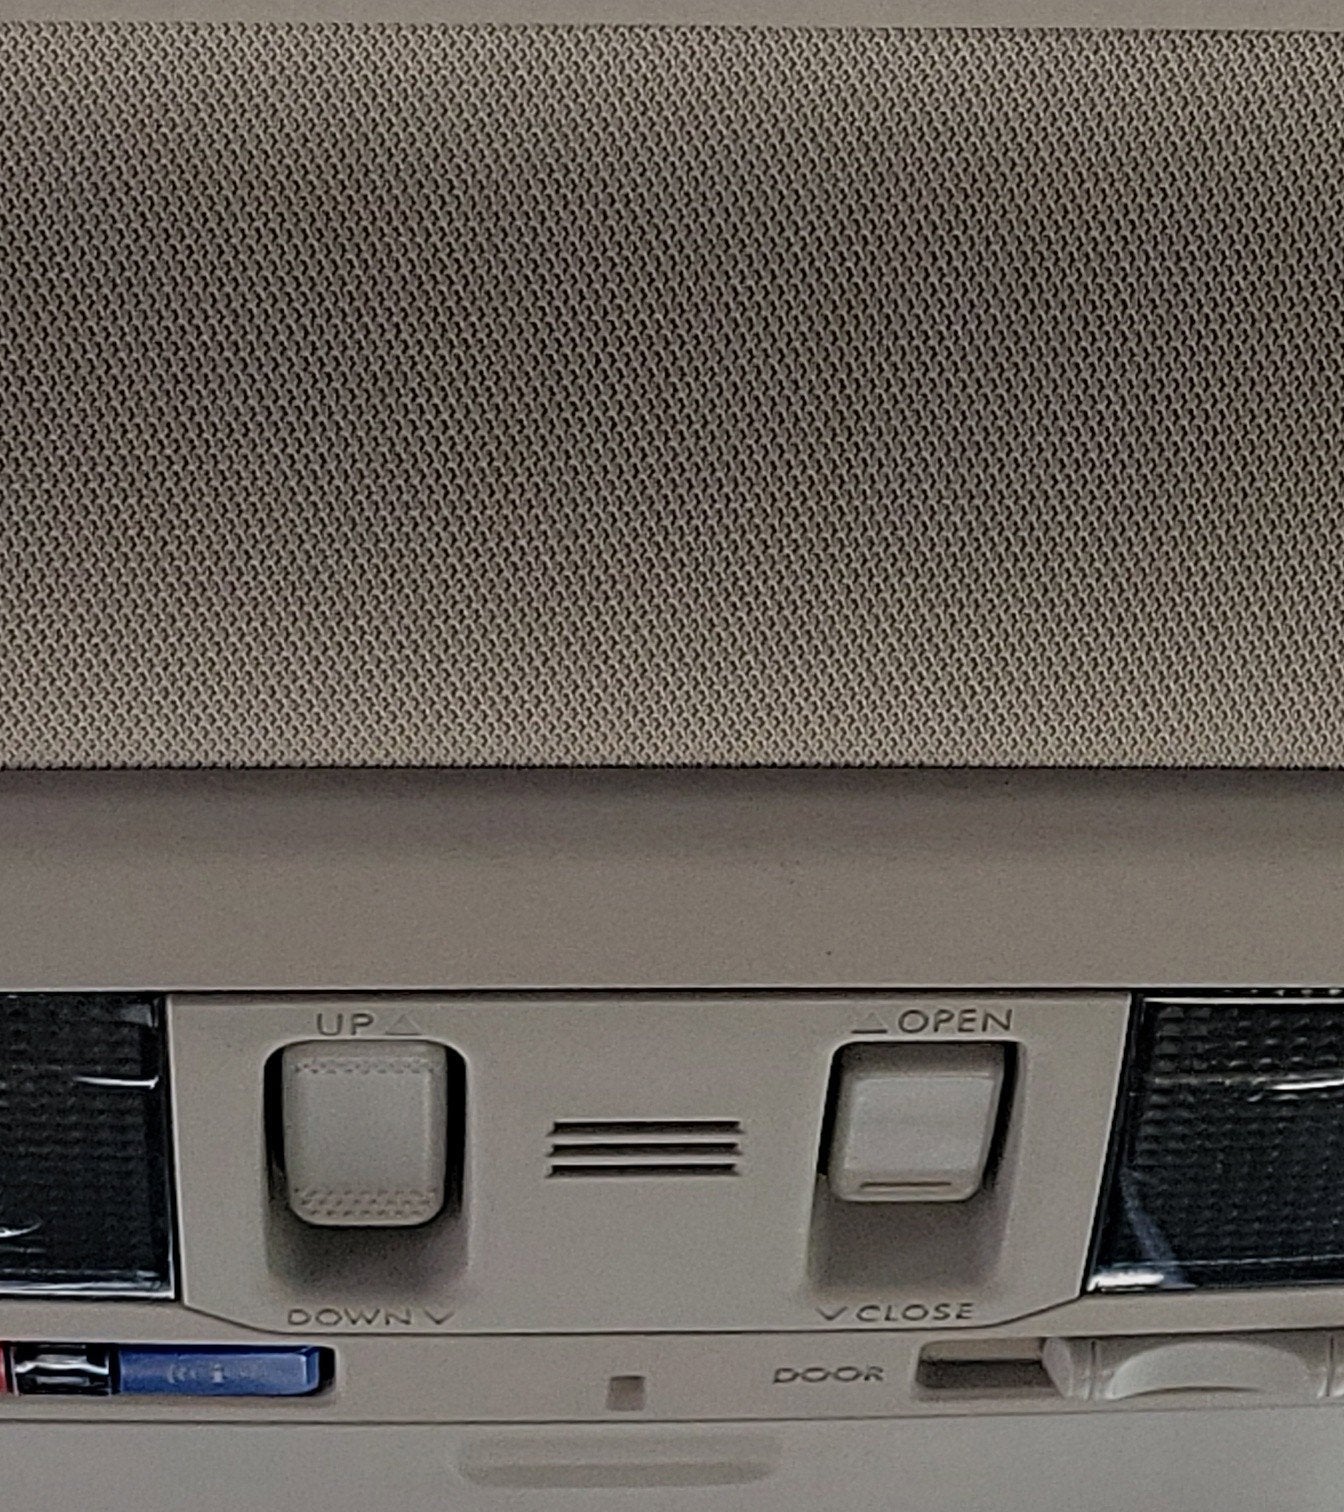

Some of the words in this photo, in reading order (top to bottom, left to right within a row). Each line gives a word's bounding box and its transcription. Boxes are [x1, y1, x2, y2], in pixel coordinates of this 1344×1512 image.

[316, 1012, 373, 1036] UP
[898, 1009, 1012, 1034] OPEN
[287, 1308, 411, 1326] DOWN
[856, 1303, 975, 1321] CLOSE
[772, 1366, 885, 1384] DOOR
